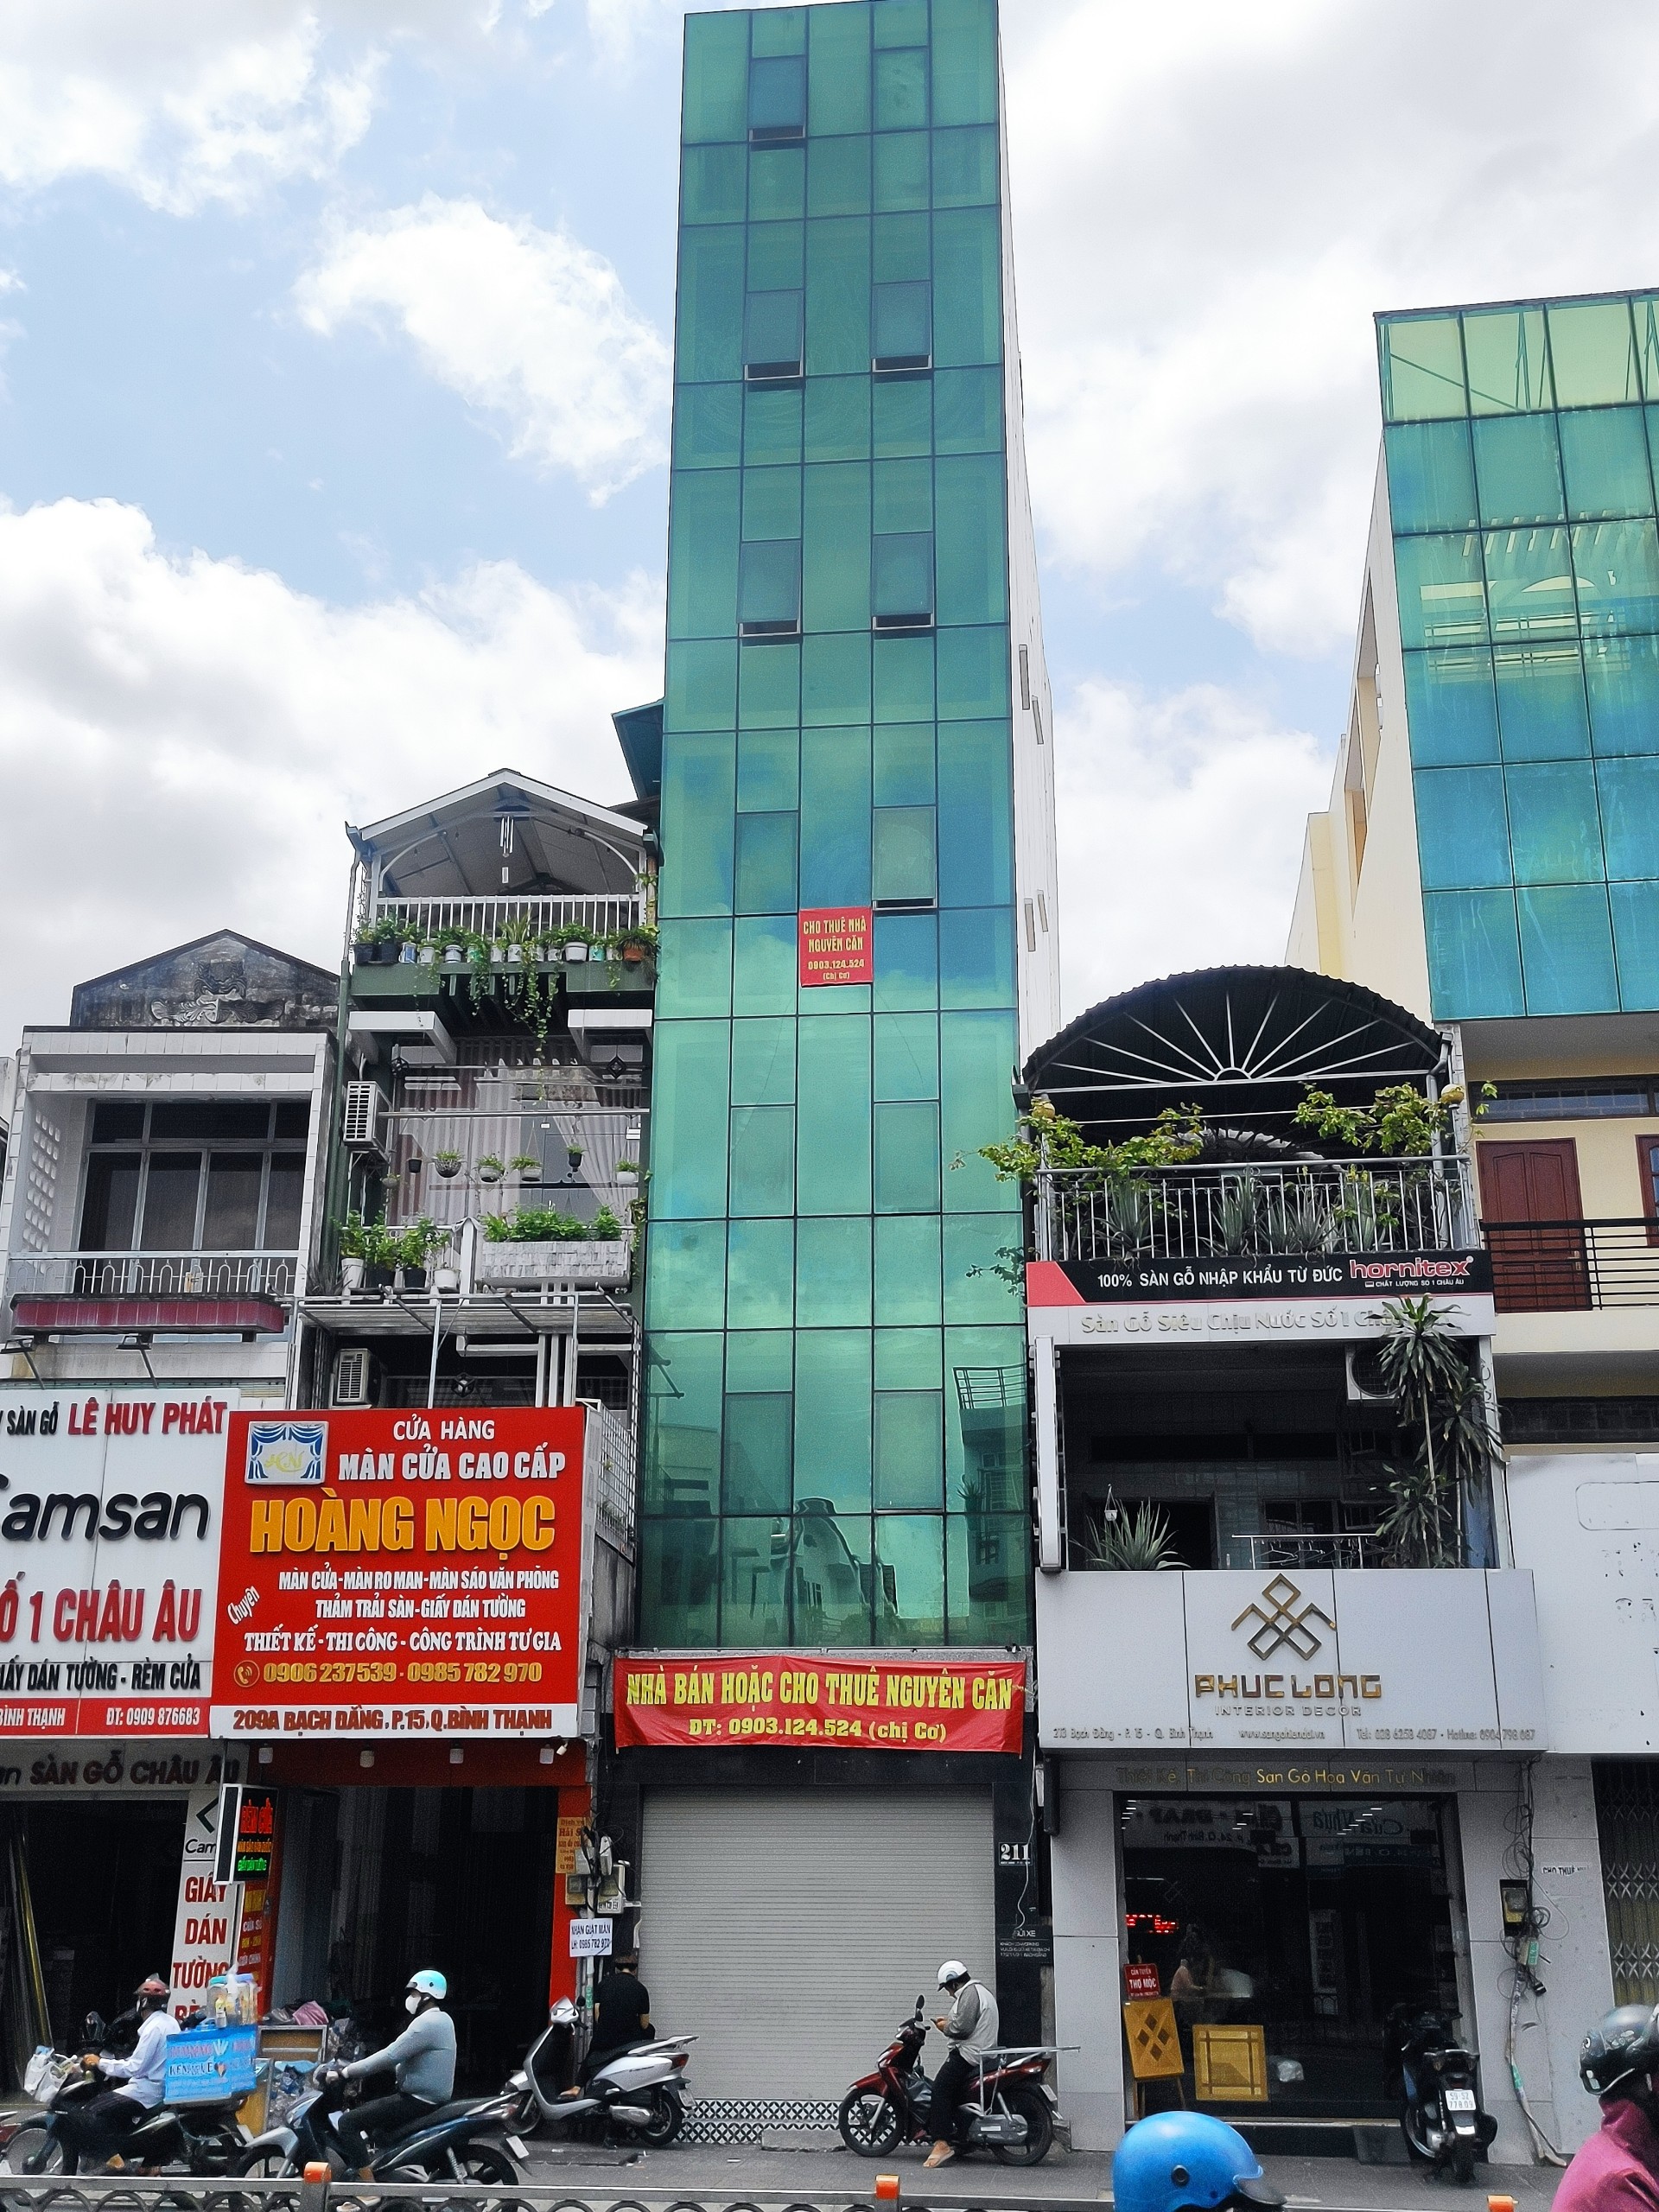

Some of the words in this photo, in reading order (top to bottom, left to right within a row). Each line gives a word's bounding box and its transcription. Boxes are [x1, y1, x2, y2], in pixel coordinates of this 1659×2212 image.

[803, 920, 821, 934] CHO
[823, 917, 846, 933] THUÊ
[849, 915, 867, 932] NHÀ
[808, 936, 843, 953] NGUYÊN
[846, 935, 863, 950] CĂN
[808, 959, 865, 969] 0903.124.524
[1097, 1274, 1133, 1287] 100%
[1139, 1269, 1169, 1287] SÀN
[1173, 1266, 1195, 1286] GỖ
[1199, 1268, 1238, 1287] NHẬP
[1243, 1264, 1282, 1285] KHẨU
[1287, 1265, 1308, 1282] TỪ
[1313, 1266, 1344, 1282] ĐỨC
[1349, 1257, 1471, 1280] hornitex
[1081, 1313, 1119, 1333] Sàn
[1123, 1312, 1153, 1332] Gỗ
[1158, 1314, 1202, 1332] Siêu
[1208, 1313, 1251, 1333] Chịu
[1255, 1309, 1306, 1330] Nước
[1311, 1306, 1338, 1328] Số
[1340, 1311, 1350, 1327] 1
[7, 1405, 36, 1435] SÀN
[40, 1401, 60, 1435] GỖ
[67, 1396, 99, 1435] LÊ
[104, 1402, 157, 1435] HUY
[162, 1395, 227, 1434] PHÁT
[393, 1414, 432, 1440] CỬA
[441, 1417, 495, 1440] HÀNG
[339, 1448, 395, 1480] MÀN
[402, 1443, 452, 1480] CỬA
[459, 1451, 507, 1480] CAO
[513, 1442, 566, 1478] CẤP
[0, 1472, 211, 1541] amsan
[250, 1488, 415, 1553] HOÀNG
[425, 1496, 556, 1561] NGỌC
[278, 1567, 309, 1590] MÀN
[374, 1571, 392, 1589] RO
[461, 1566, 487, 1589] SÁO
[488, 1567, 514, 1589] VĂN
[516, 1565, 559, 1589] PHÒNG
[29, 1591, 44, 1643] 1
[53, 1579, 146, 1643] CHÂU
[152, 1579, 203, 1643] ÂU
[226, 1585, 261, 1625] Chuyên
[315, 1592, 353, 1618] THẢM
[355, 1592, 385, 1618] TRẢI
[452, 1594, 480, 1618] DÁN
[481, 1592, 526, 1618] TƯỜNG
[245, 1623, 292, 1652] THIẾT
[294, 1622, 317, 1652] KẾ
[326, 1631, 355, 1652] THI
[355, 1627, 398, 1652] CÔNG
[409, 1627, 453, 1652] CÔNG
[454, 1624, 507, 1651] TRÌNH
[533, 1631, 563, 1651] GIA
[27, 1657, 60, 1691] DÁN
[66, 1656, 118, 1691] TƯỜNG
[130, 1657, 167, 1691] RÈM
[169, 1652, 201, 1690] CỬA
[263, 1662, 317, 1683] 0906
[319, 1662, 397, 1683] 237539
[407, 1662, 461, 1682] 0985
[464, 1662, 500, 1682] 782
[504, 1662, 543, 1682] 970
[626, 1664, 667, 1706] NHÀ
[674, 1665, 714, 1705] BÁN
[721, 1665, 772, 1713] HOẶC
[780, 1671, 819, 1705] CHO
[825, 1666, 880, 1707] THUÊ
[886, 1667, 965, 1710] NGUYÊN
[971, 1669, 1014, 1710] CĂN
[27, 1707, 66, 1730] THẠNH
[126, 1707, 156, 1726] 0909
[157, 1707, 200, 1726] 876683
[232, 1709, 280, 1731] 209A
[493, 1709, 553, 1736] THẠNH
[1215, 1705, 1295, 1717] INTERIOR
[1302, 1706, 1362, 1717] DECOR
[689, 1719, 723, 1738] ĐT:
[728, 1717, 863, 1738] 0903.124.524
[868, 1719, 908, 1744] (chị
[913, 1720, 948, 1743] Cơ)
[29, 1753, 79, 1785] SÀN
[83, 1749, 124, 1785] GỖ
[130, 1753, 200, 1785] CHÂU
[1315, 1769, 1345, 1784] Hoa
[1001, 1843, 1031, 1860] 211
[185, 1913, 227, 1945] DÁN
[599, 1922, 610, 1934] MÀN
